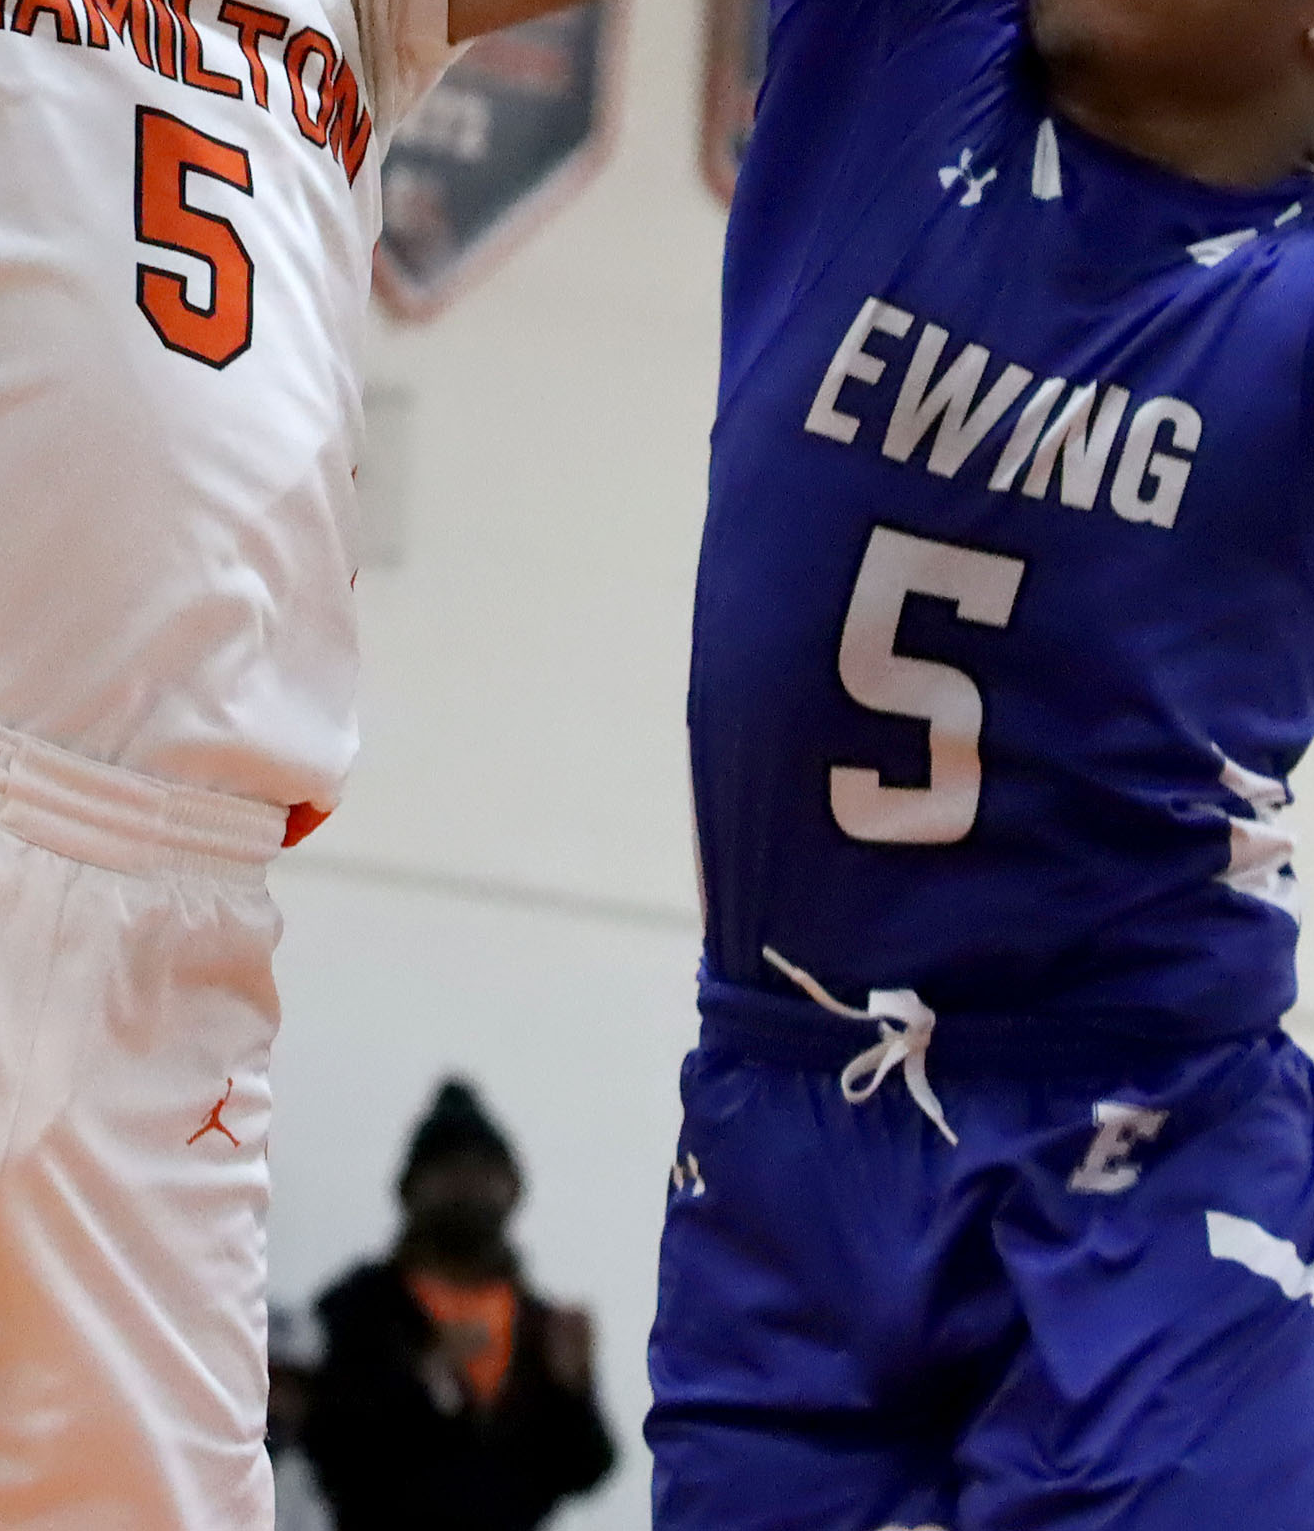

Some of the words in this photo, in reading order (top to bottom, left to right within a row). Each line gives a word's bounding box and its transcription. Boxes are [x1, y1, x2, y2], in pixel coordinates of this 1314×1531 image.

[135, 104, 254, 371] 5
[803, 296, 1203, 529] EWING
[829, 525, 1026, 845] 5
[1067, 1100, 1168, 1195] E
